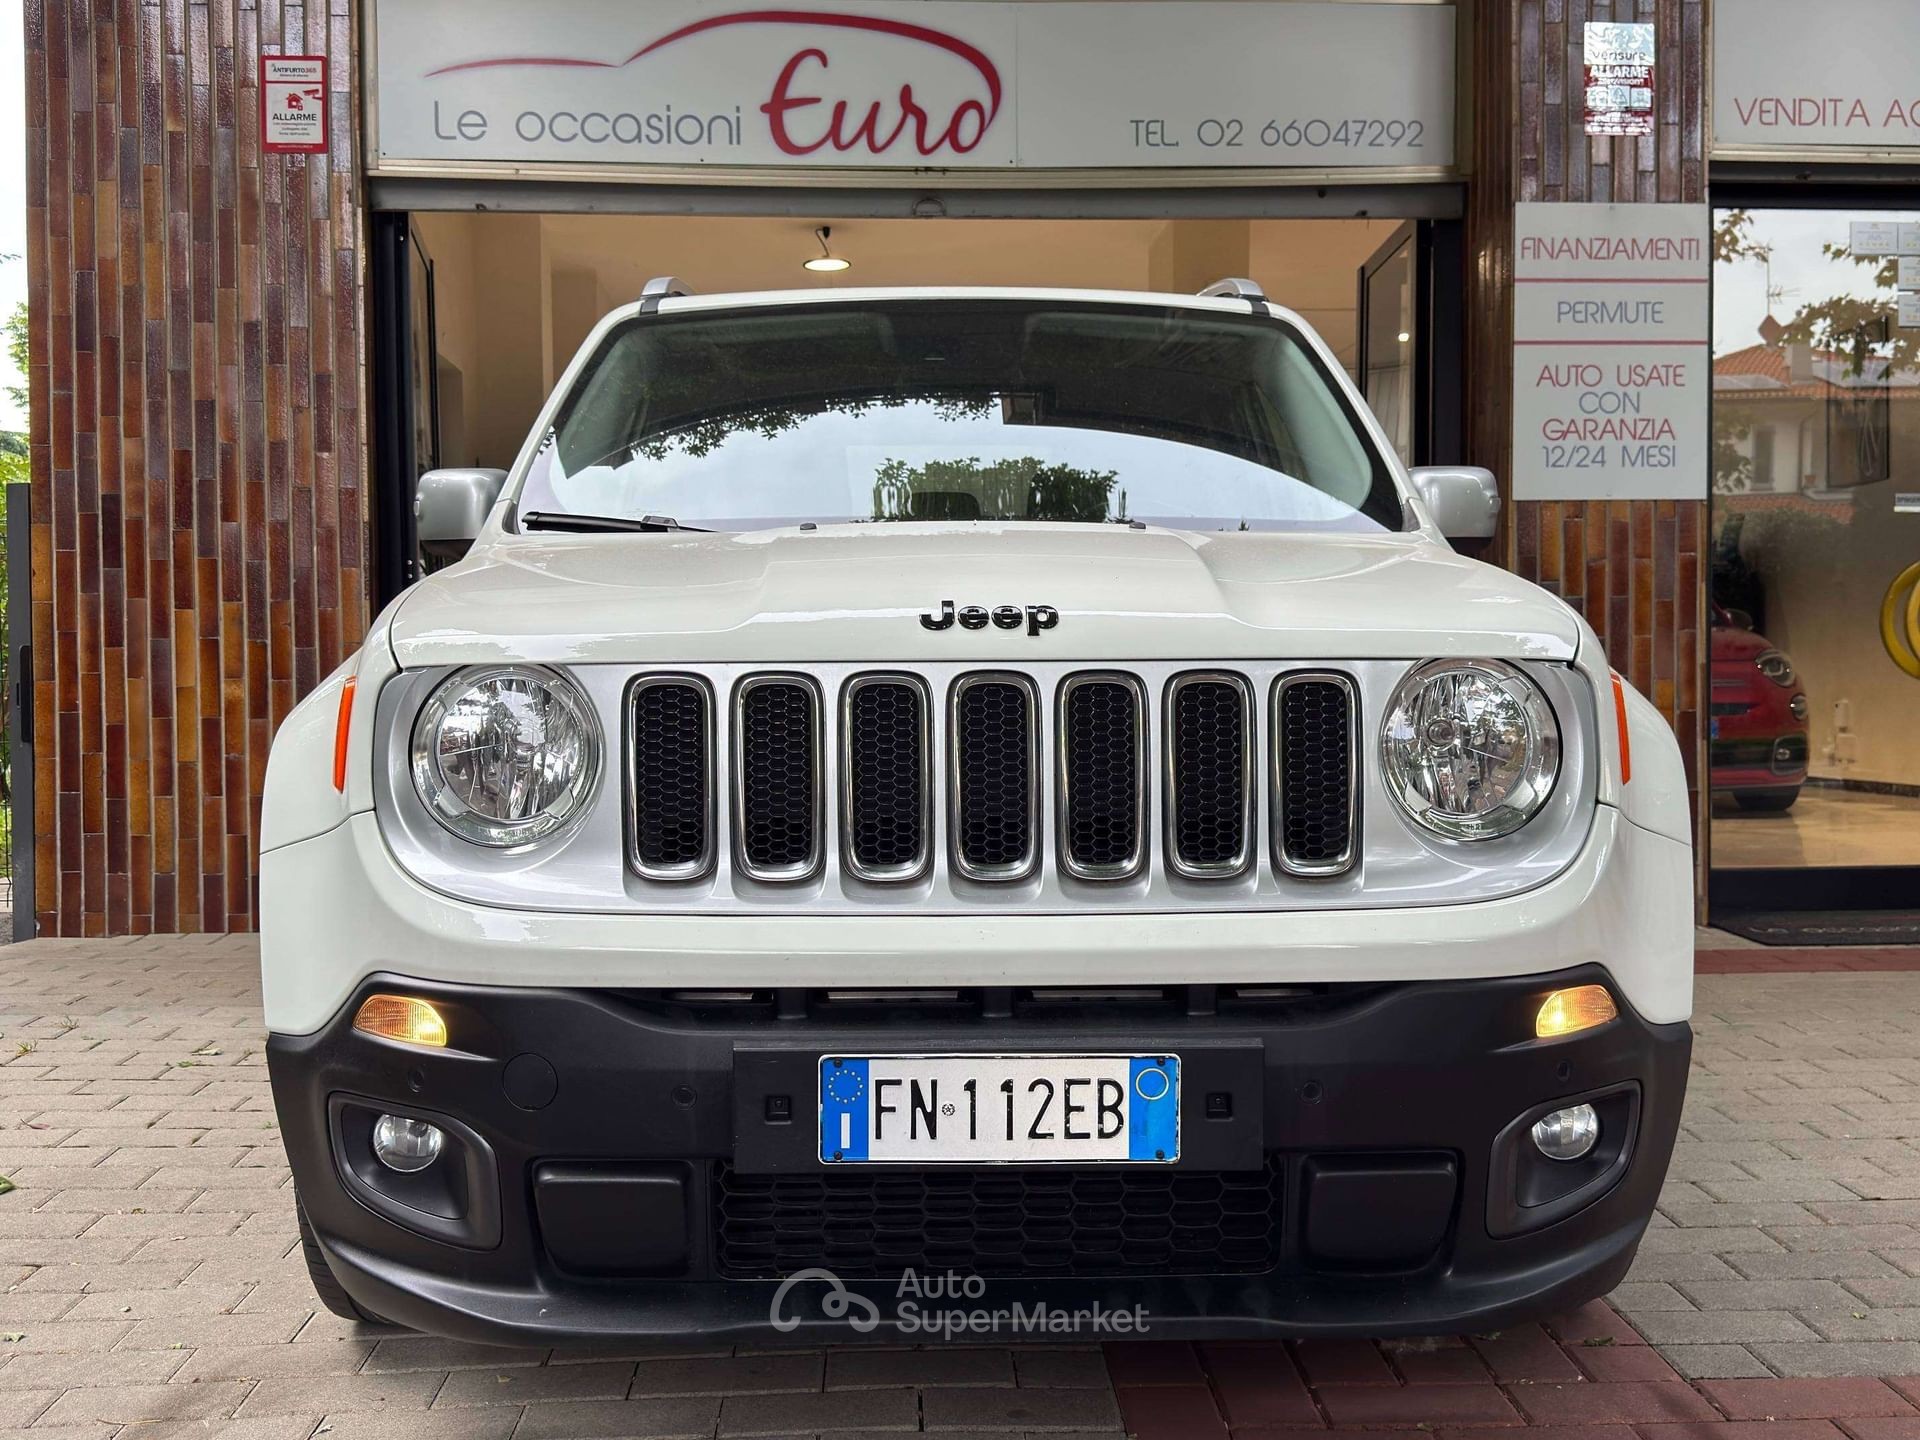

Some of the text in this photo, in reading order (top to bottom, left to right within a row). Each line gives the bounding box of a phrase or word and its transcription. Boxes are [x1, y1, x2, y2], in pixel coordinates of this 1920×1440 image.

[1590, 65, 1649, 78] ALLARME
[434, 48, 987, 157] Le occasioni Euro
[1734, 97, 1871, 127] VENDITA
[272, 113, 317, 121] ALLARME
[1130, 119, 1424, 148] TEL. 02 66047292
[1520, 237, 1700, 260] FINANZIAMENTI
[1557, 301, 1664, 323] PERMUTE
[1536, 364, 1685, 387] AUTO USATE
[1578, 391, 1640, 414] CON
[1542, 418, 1676, 441] GARANZIA
[1542, 445, 1676, 468] 12/24 MESI
[919, 600, 1060, 636] Jeep
